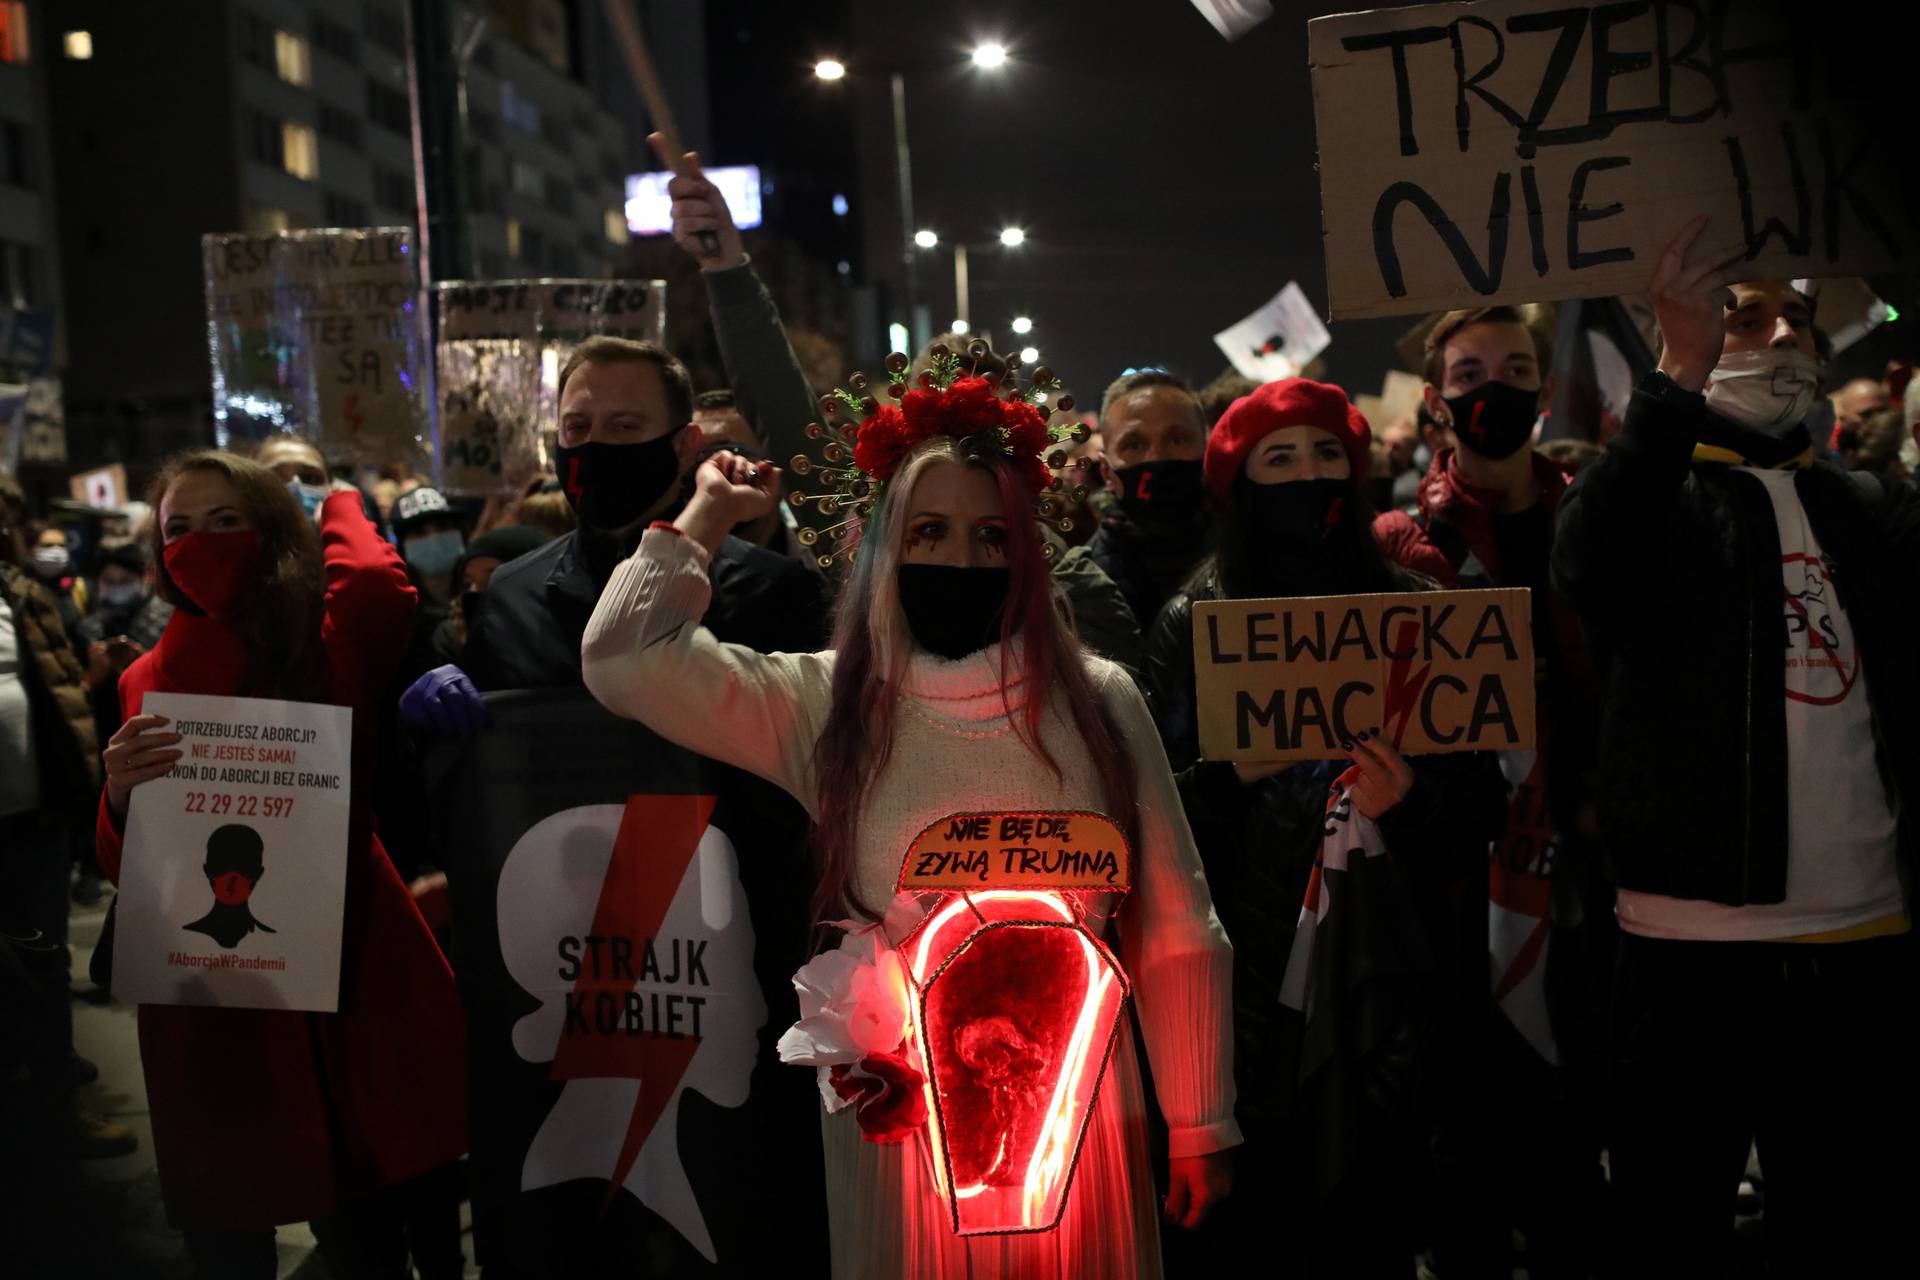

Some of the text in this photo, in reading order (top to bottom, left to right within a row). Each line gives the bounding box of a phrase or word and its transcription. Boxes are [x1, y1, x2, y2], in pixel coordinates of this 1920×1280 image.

[1372, 157, 1635, 297] NIE
[1206, 604, 1519, 664] LEWACKA
[175, 720, 316, 744] POTRZEBUJESZ ABORCJI?
[191, 744, 296, 765] NIE JESTEŚ SAMA!
[201, 766, 217, 782] DO
[220, 768, 270, 785] ABORCJI
[274, 772, 295, 786] BEZ
[298, 774, 340, 790] GRANIC
[185, 792, 294, 818] 22 29 22 597
[944, 816, 1073, 845] NIE BĘDĘ
[1000, 847, 1119, 883] TRUMNĄ
[168, 952, 285, 970] #AborcjaWPandemii
[558, 935, 710, 987] STRAJK
[565, 991, 706, 1044] KOBIET
